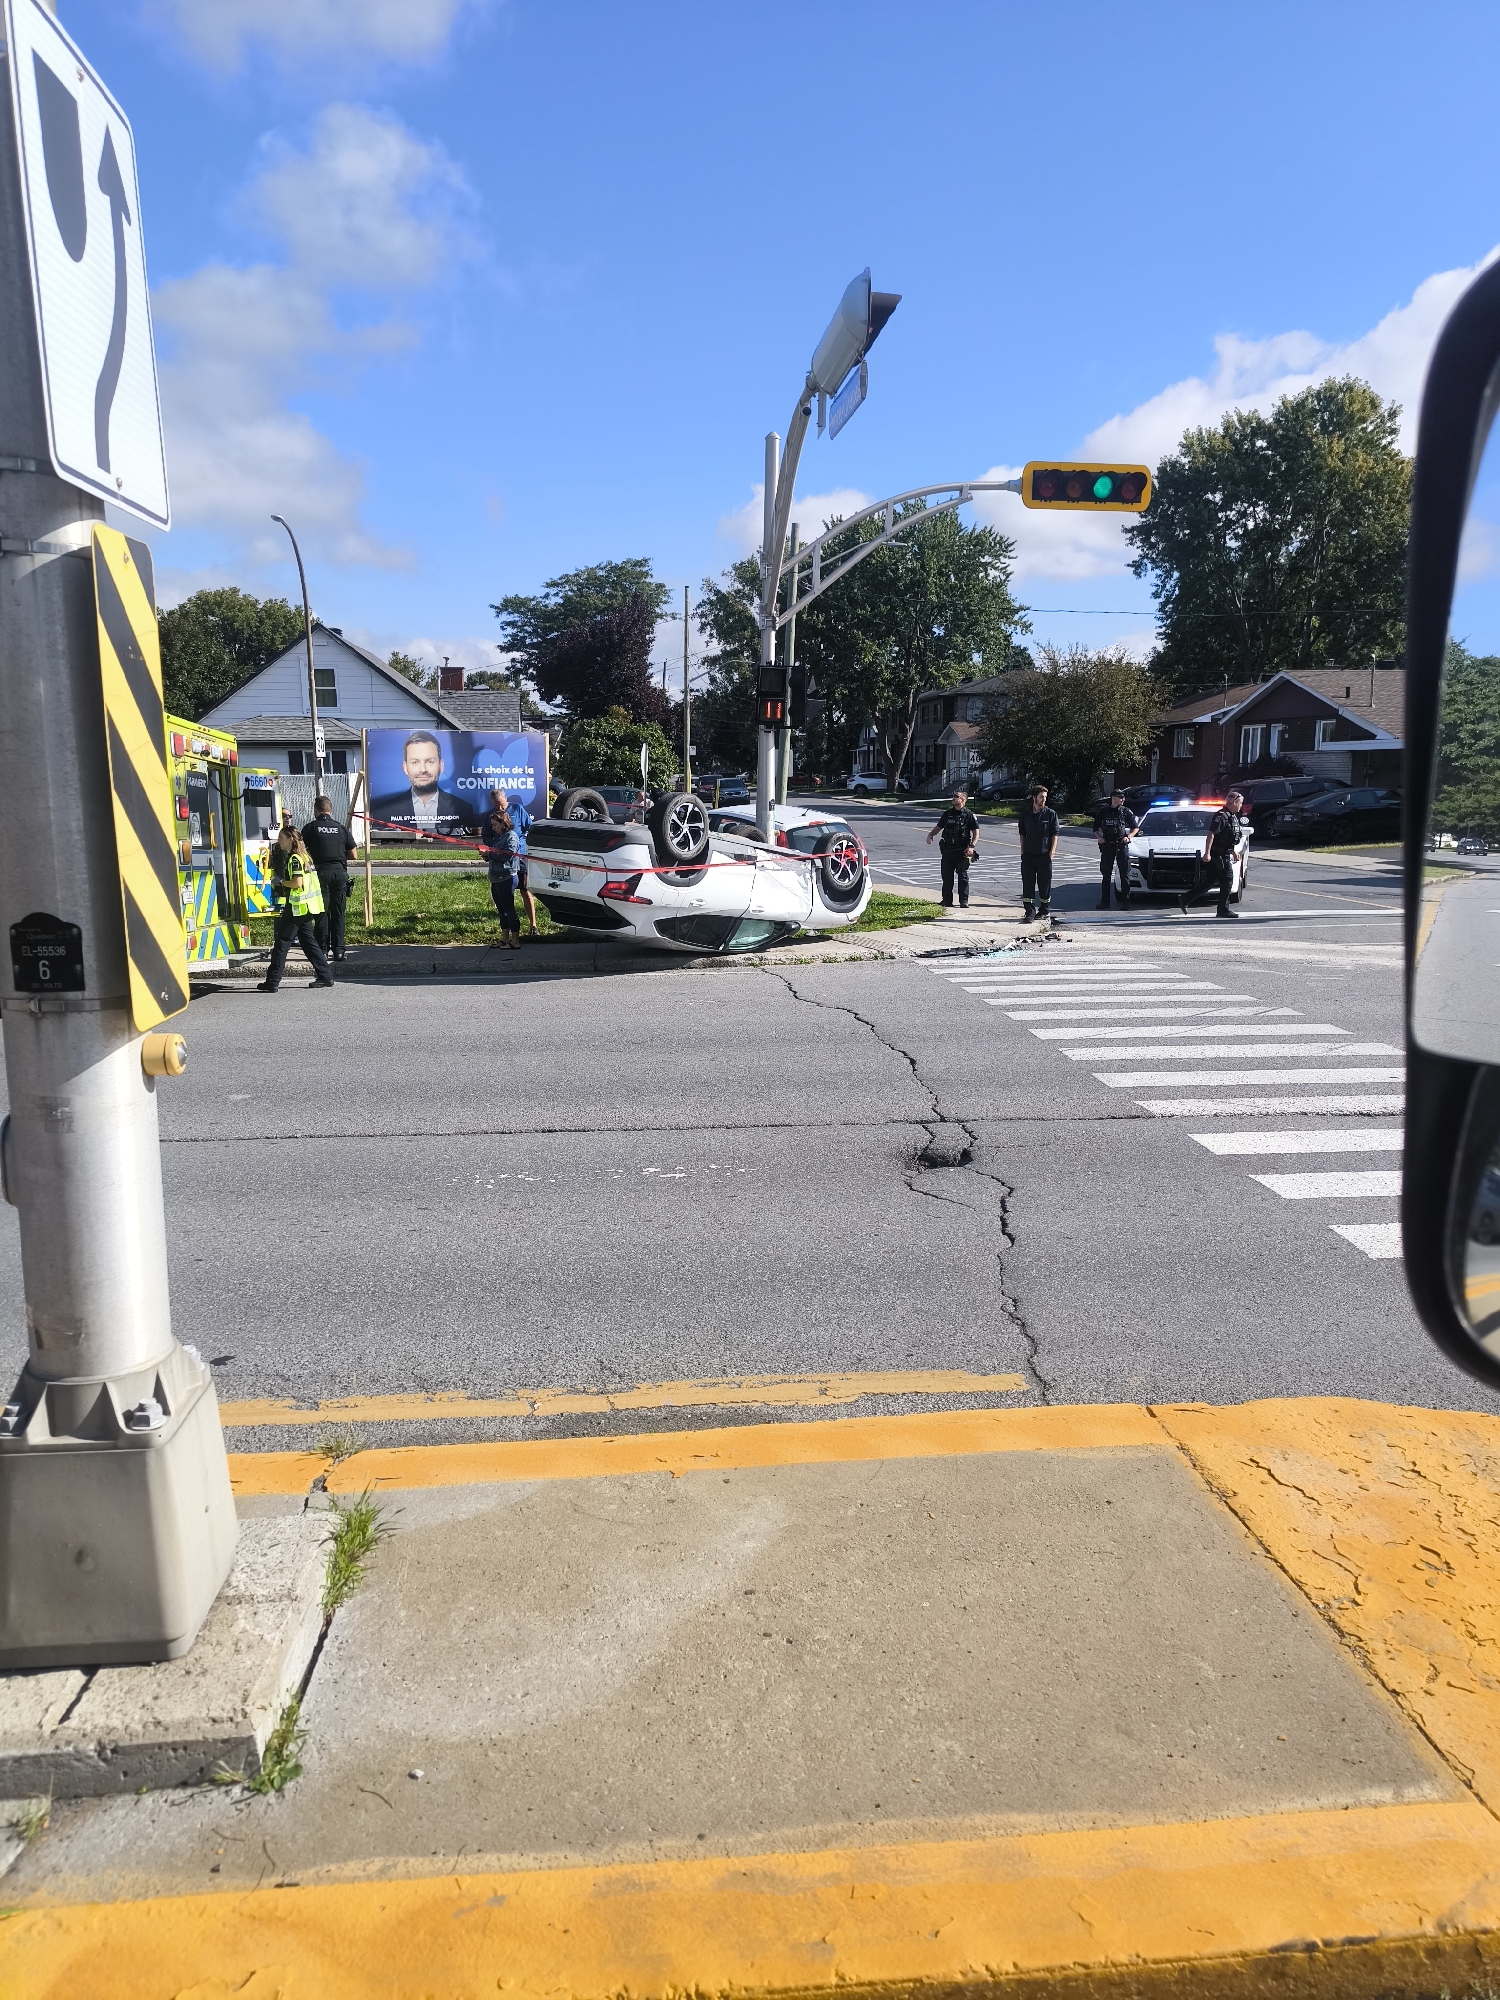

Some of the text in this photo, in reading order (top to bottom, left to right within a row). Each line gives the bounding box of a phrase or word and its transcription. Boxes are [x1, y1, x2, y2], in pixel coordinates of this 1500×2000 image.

[766, 701, 782, 719] 11
[471, 765, 534, 774] Le choix de la
[249, 775, 268, 788] 6660
[456, 777, 535, 790] CONFIANCE
[317, 826, 339, 834] POLICE
[21, 945, 66, 956] EL-55536
[38, 960, 51, 980] 6
